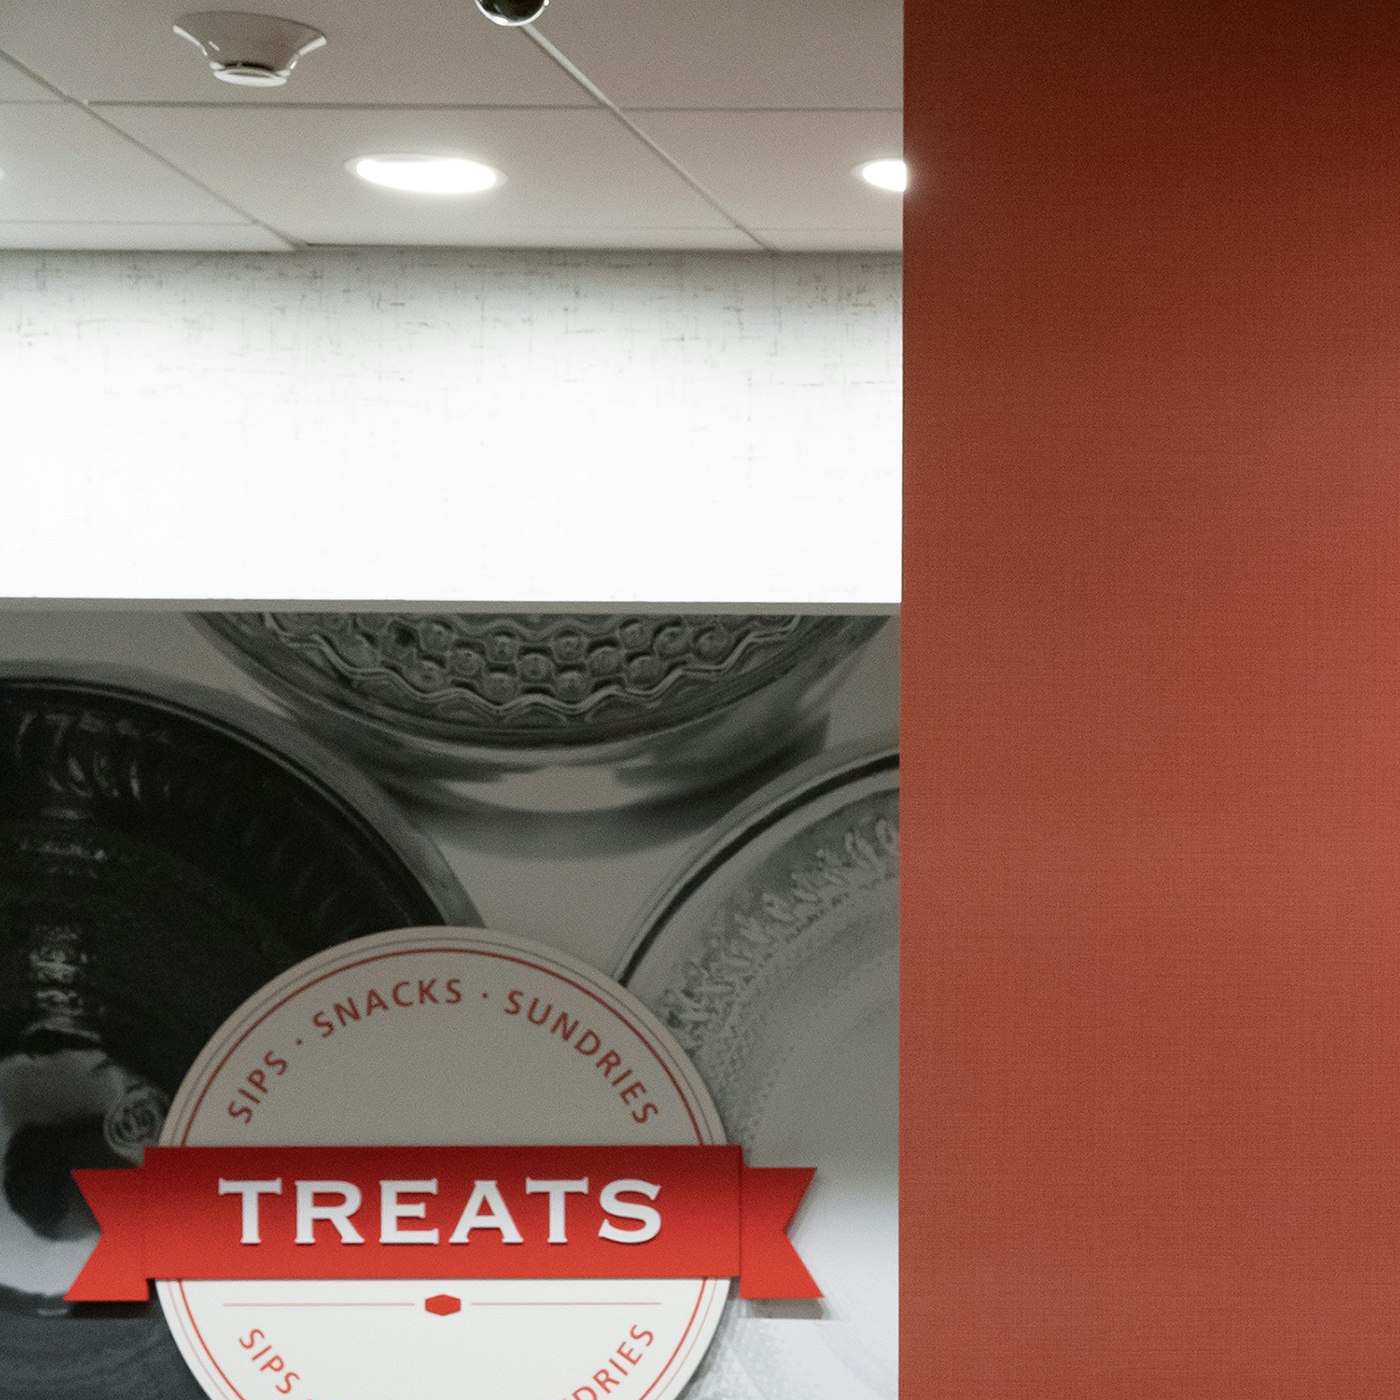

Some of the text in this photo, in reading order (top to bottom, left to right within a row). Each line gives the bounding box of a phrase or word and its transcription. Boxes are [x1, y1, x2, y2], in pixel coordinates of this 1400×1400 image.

[227, 977, 661, 1127] SIPS SNACKS SUNDRIES
[218, 1177, 664, 1245] TREATS
[239, 1326, 300, 1398] SIPS
